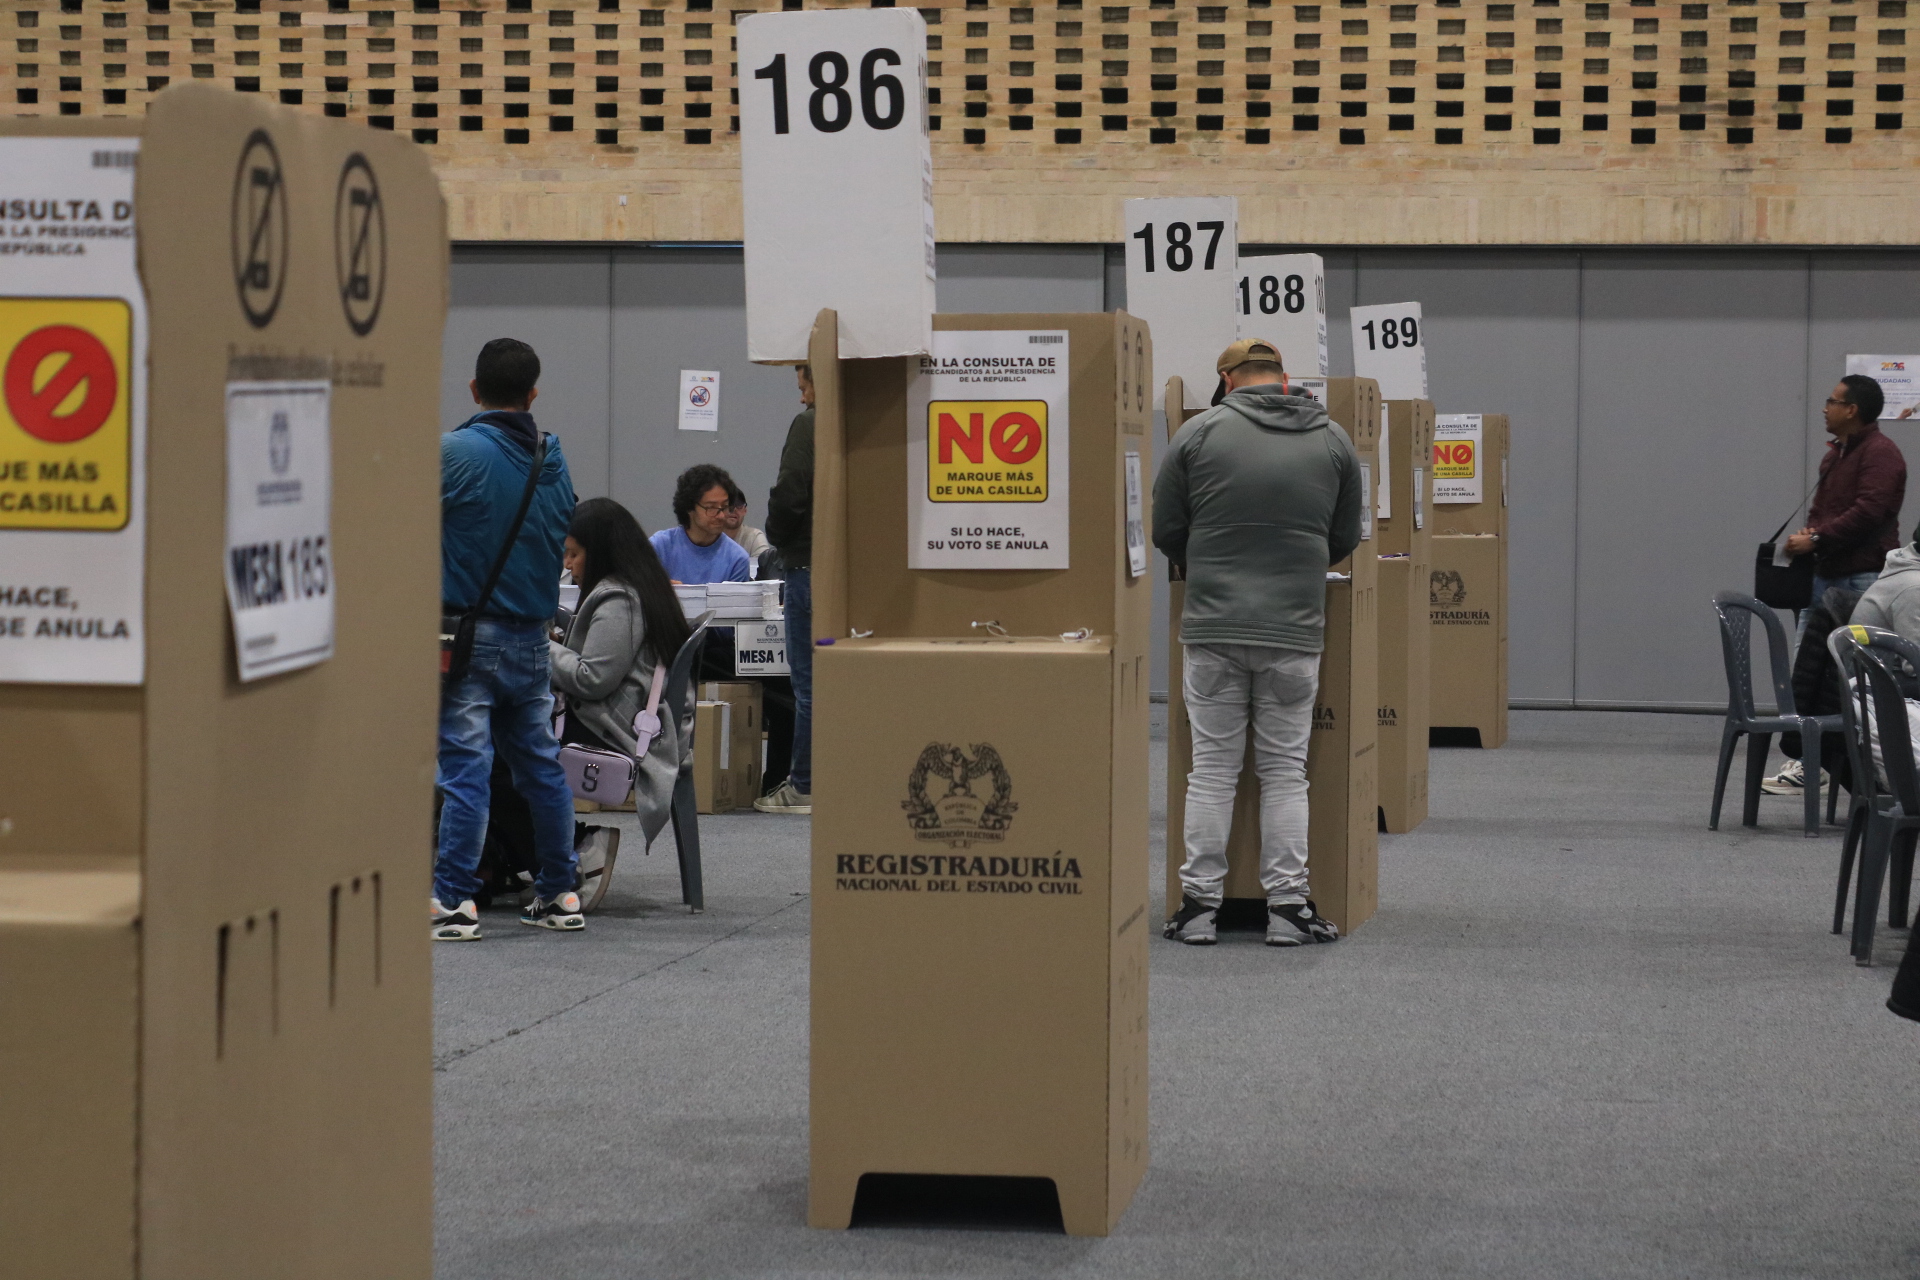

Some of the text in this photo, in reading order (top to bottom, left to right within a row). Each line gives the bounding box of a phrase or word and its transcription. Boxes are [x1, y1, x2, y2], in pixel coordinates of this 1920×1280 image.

[754, 48, 905, 135] 186
[1133, 220, 1225, 272] 187
[1239, 274, 1305, 315] 188
[1361, 317, 1418, 351] 189
[920, 357, 1056, 367] EN LA CONSULTA DE
[38, 458, 99, 482] MÁS
[947, 470, 1034, 482] MARQUE MÁS
[936, 486, 1043, 495] DE UNA CASILLA
[0, 492, 118, 513] CASILLA
[951, 527, 1025, 538] SI LO HACE,
[927, 541, 1049, 550] SU VOTO SE ANULA
[231, 535, 327, 611] MESA 185
[35, 618, 130, 639] ANULA
[740, 650, 774, 663] MESA
[837, 850, 1082, 878] REGISTRADURÍA
[836, 878, 1082, 895] NACIONAL DEL ESTADO CIVIL
